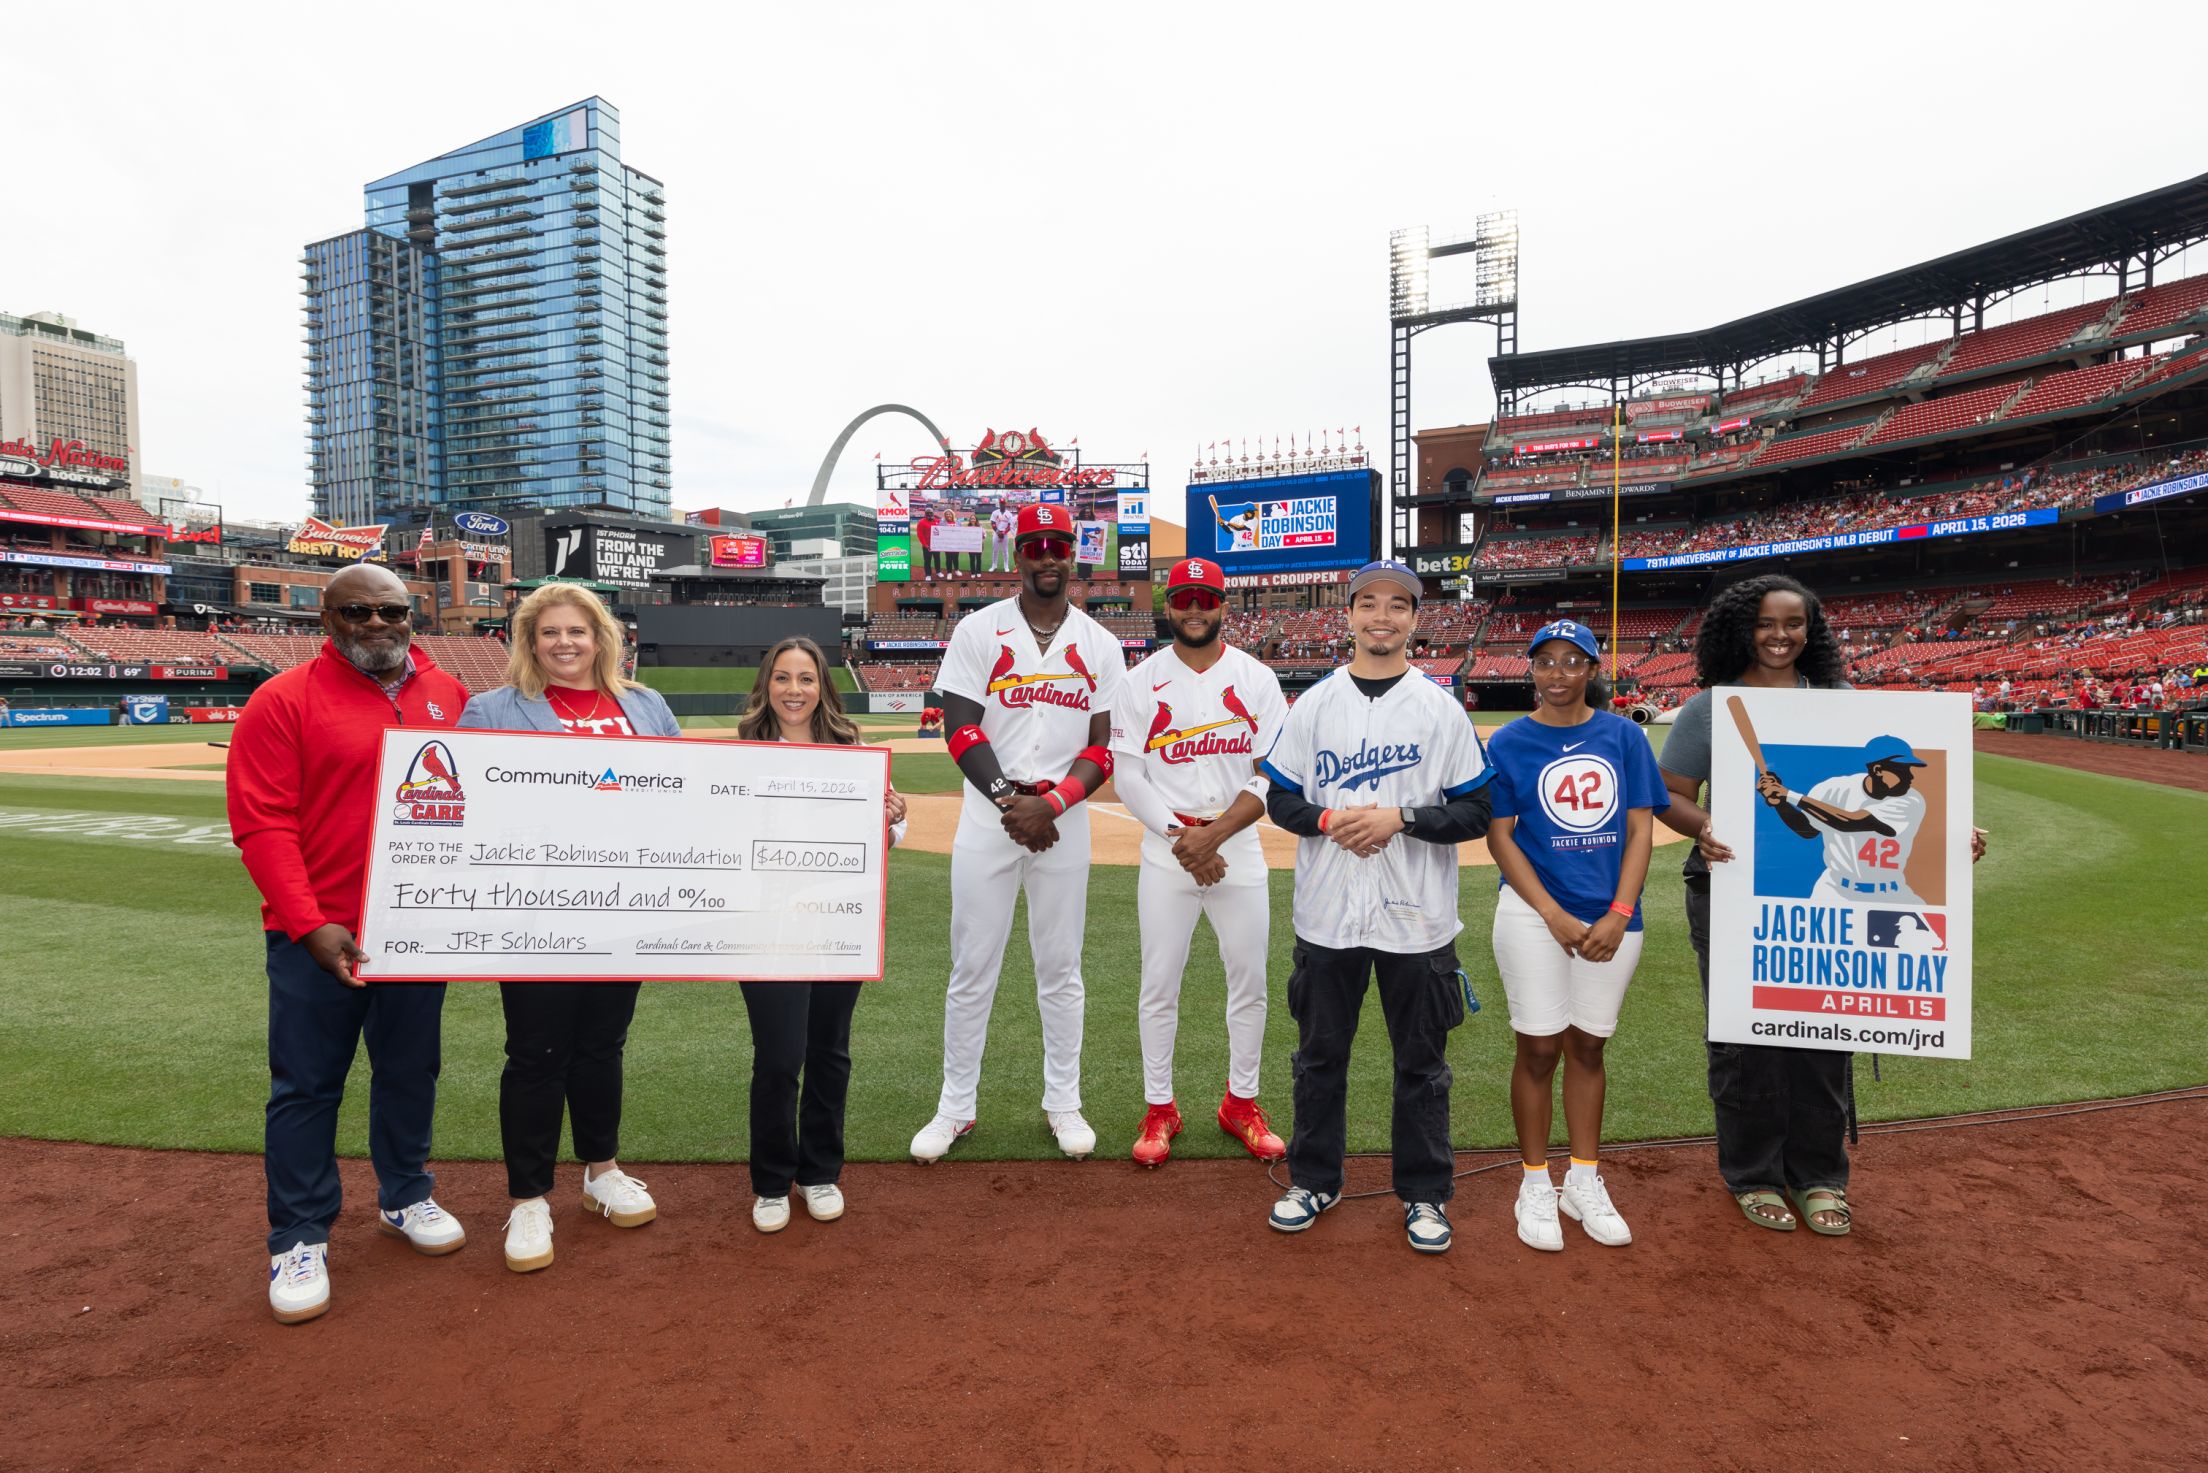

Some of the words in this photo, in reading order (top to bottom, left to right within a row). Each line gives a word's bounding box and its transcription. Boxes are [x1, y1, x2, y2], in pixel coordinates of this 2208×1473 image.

[1652, 377, 1699, 387] BUDWEISER
[1659, 398, 1706, 408] BUDWEISER
[37, 437, 125, 472] Nation
[910, 456, 1117, 489] Budweiser
[1206, 467, 1261, 478] WORLD
[1261, 457, 1352, 475] CHAMPIONS
[49, 470, 111, 486] ROOFTOP
[1565, 488, 1605, 497] BENJAMIN
[2141, 488, 2161, 500] JACKIE
[2162, 478, 2198, 494] ROBINSON
[1290, 498, 1335, 515] JACKIE
[1496, 495, 1513, 503] JACKIE
[1513, 494, 1539, 502] ROBINSON
[878, 508, 908, 516] KMOX
[466, 514, 500, 532] Ford
[1261, 514, 1335, 534] ROBINSON
[296, 524, 379, 545] Budweise
[608, 531, 636, 539] PHORM
[1242, 532, 1253, 541] 42
[1261, 535, 1281, 548] DAY
[1295, 536, 1313, 544] APRIL
[1646, 558, 1669, 568] 79TH
[1669, 552, 1727, 566] ANNIVERSARY
[1738, 546, 1770, 558] JACKIE
[1772, 537, 1832, 554] ROBINSON'S
[1833, 535, 1856, 547] MLB
[1858, 530, 1894, 544] DEBUT
[1932, 519, 1969, 535] APRIL
[1971, 518, 1990, 532] 15,
[1992, 513, 2027, 528] 2026
[289, 542, 334, 556] BREW
[460, 541, 510, 555] Community
[596, 538, 642, 553] FROM
[643, 544, 665, 557] THE
[1120, 542, 1148, 560] stl
[51, 557, 89, 567] ROBINSON
[596, 552, 625, 564] LOU
[626, 555, 656, 567] AND
[1416, 556, 1470, 573] bet36
[596, 564, 640, 579] WE'RE
[1224, 576, 1258, 587] ROWN
[1272, 572, 1339, 585] CROUPPEN
[1547, 622, 1576, 637] 42
[70, 667, 102, 676] 12:02
[999, 674, 1092, 711] Cardinals
[15, 713, 64, 722] Spectrum
[1160, 729, 1252, 764] Cardinals
[1315, 738, 1422, 792] Dodgers
[395, 782, 466, 803] Cardinals
[710, 785, 750, 796] DATE:
[767, 780, 796, 792] April
[799, 782, 817, 793] 15,
[821, 782, 856, 793] 2026
[991, 778, 1007, 793] 42
[1554, 771, 1603, 811] 42
[411, 804, 465, 820] CARE
[388, 842, 412, 852] PAY
[418, 842, 434, 852] TO
[440, 842, 463, 853] THE
[1552, 838, 1579, 847] JACKIE
[1582, 835, 1617, 845] ROBINSON
[391, 854, 435, 865] ORDER
[440, 855, 458, 865] OF
[469, 843, 537, 862] Jackie
[540, 843, 629, 863] Robinson
[637, 846, 742, 867] Foundation
[757, 846, 859, 867] $40,000.00
[1858, 838, 1901, 869] 42
[394, 883, 477, 911] Forty
[487, 882, 620, 907] thousand
[628, 886, 670, 908] and
[1753, 904, 1854, 945] JACKIE
[384, 941, 425, 954] FOR:
[446, 931, 494, 951] JRF
[501, 931, 587, 951] Scholars
[636, 939, 679, 950] Cardinals
[680, 941, 702, 950] Care
[703, 941, 714, 951] &
[834, 942, 862, 951] Union
[1752, 945, 1887, 989] ROBINSON
[1897, 953, 1948, 993] DAY
[1821, 994, 1899, 1015] APRIL
[1907, 999, 1933, 1017] 15
[1751, 1021, 1945, 1051] cardinals.com/jrd
